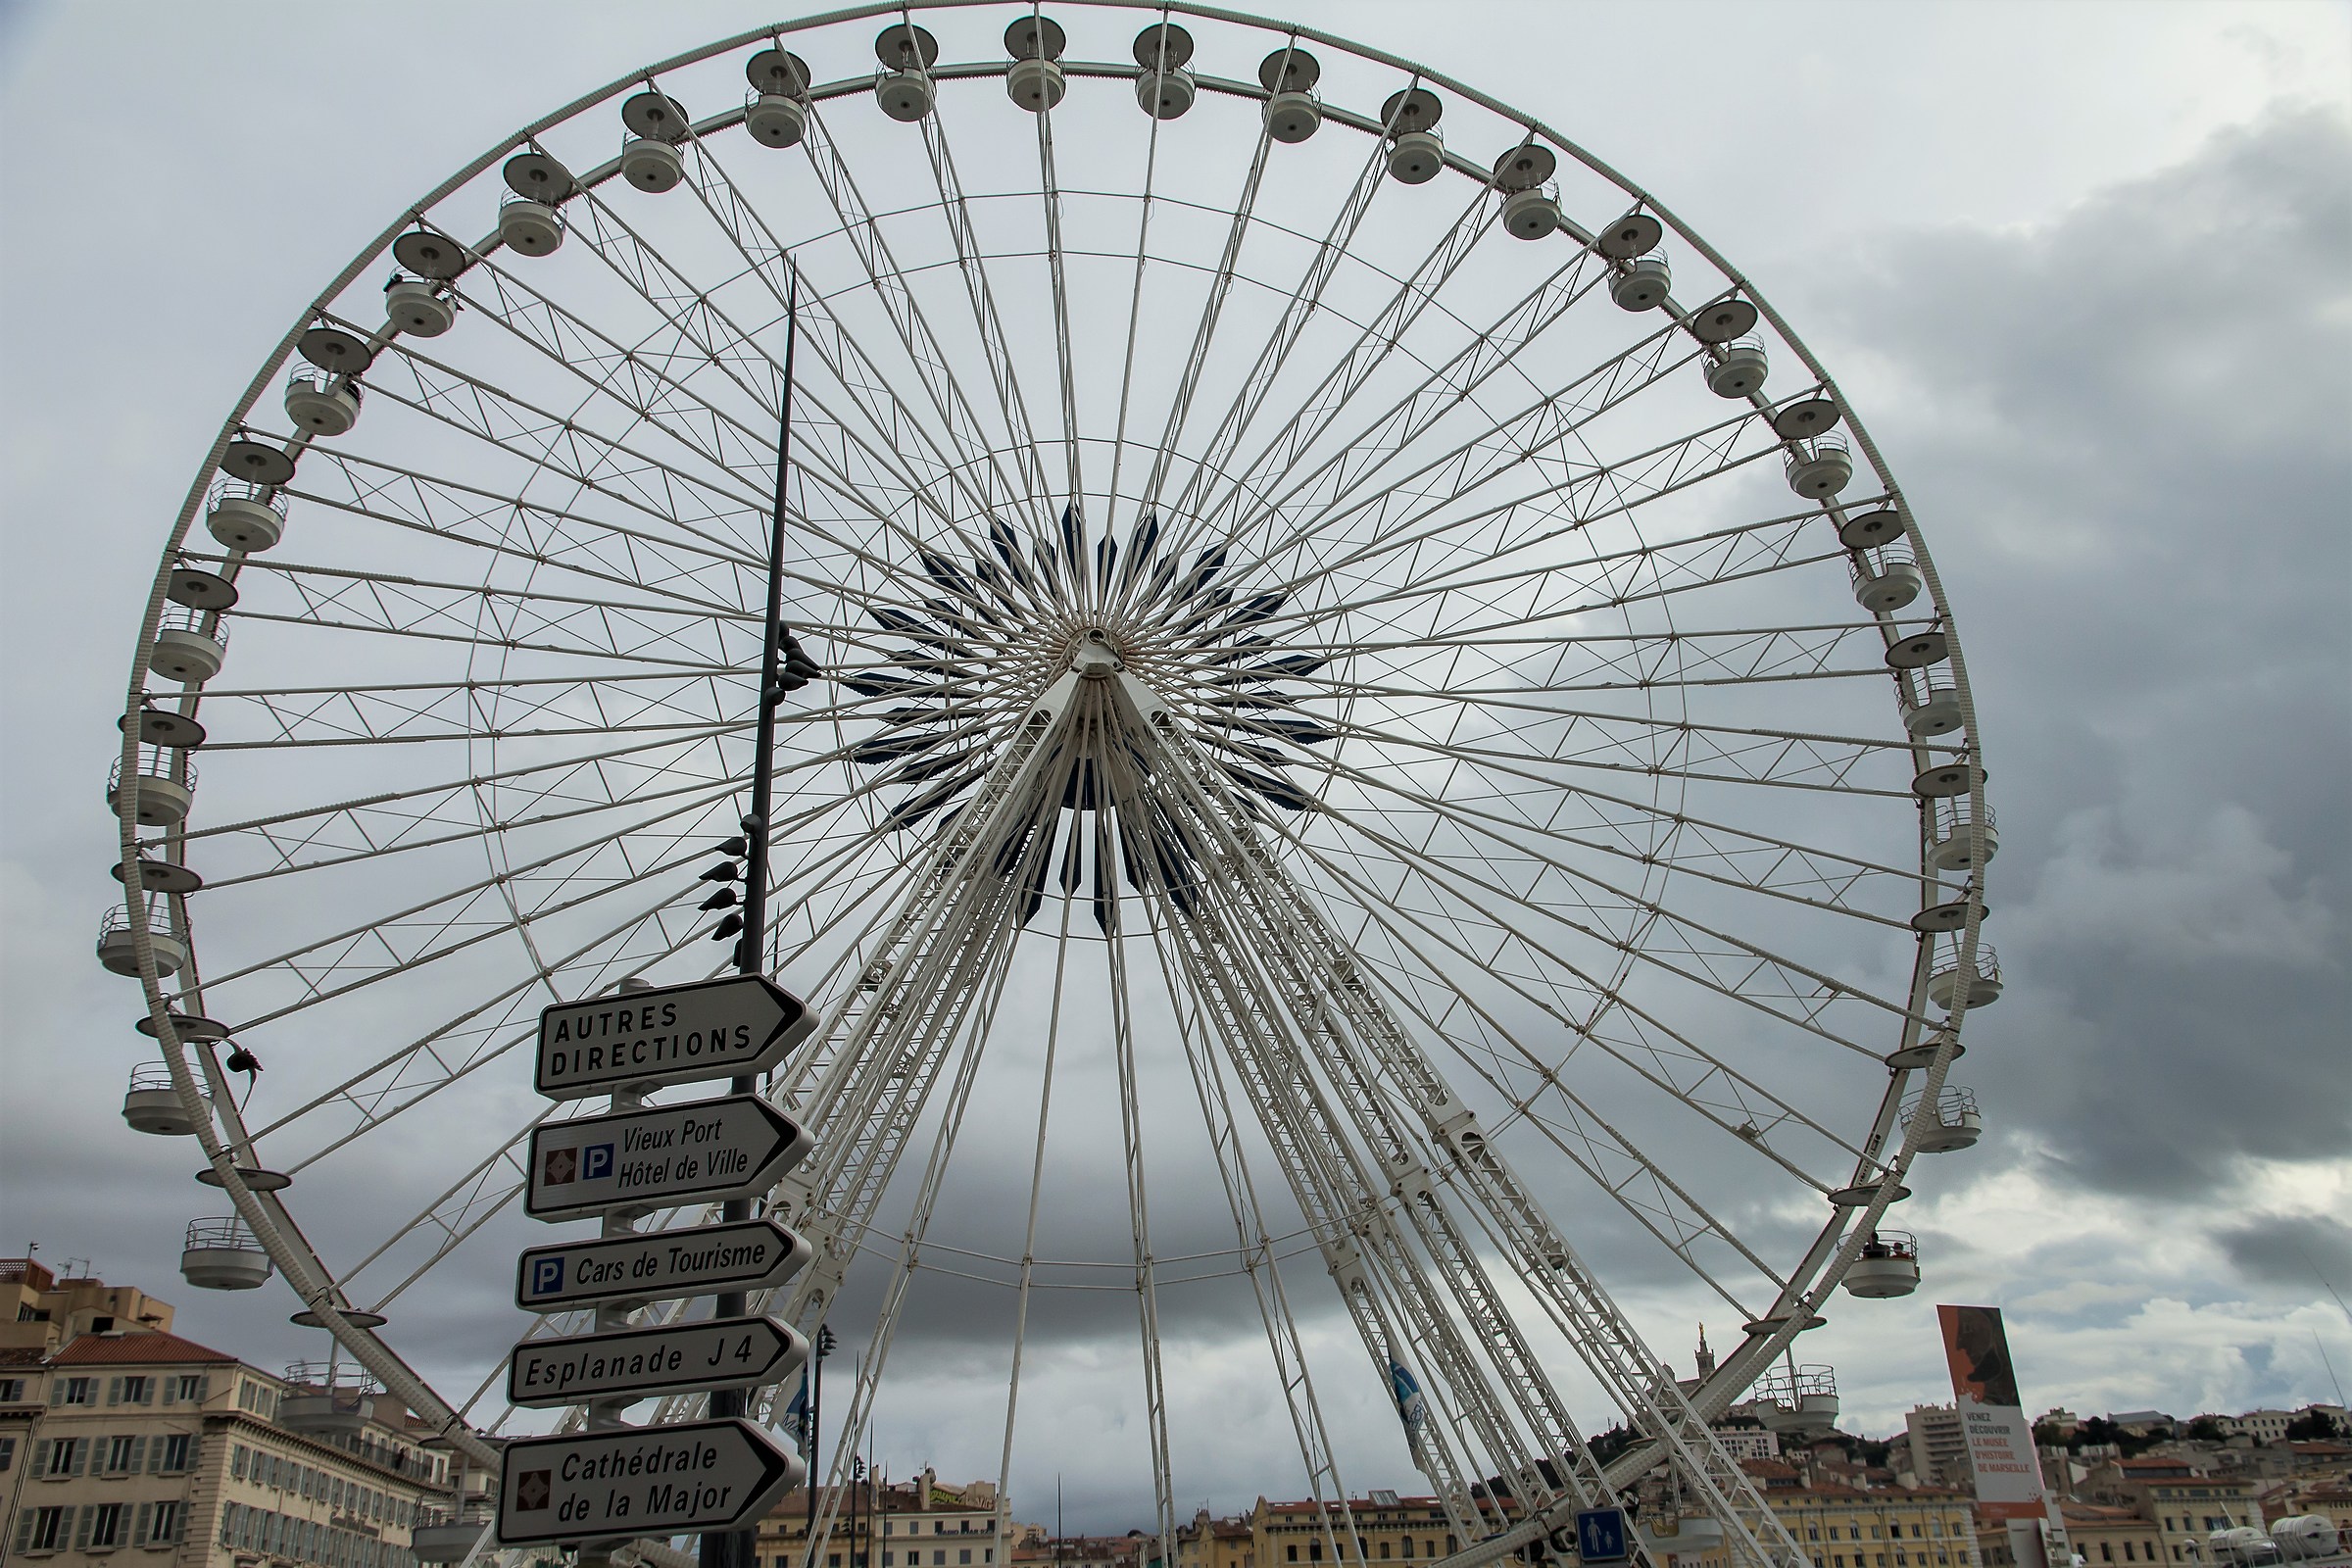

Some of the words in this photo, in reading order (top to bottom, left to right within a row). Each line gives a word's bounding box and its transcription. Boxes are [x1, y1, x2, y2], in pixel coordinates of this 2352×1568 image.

[555, 1003, 677, 1044] AUTRES
[551, 1025, 751, 1076] DIRECTIONS
[624, 1128, 675, 1153] Vieux
[680, 1118, 722, 1146] Port
[617, 1154, 670, 1189] Hôtel
[675, 1153, 699, 1179] de
[707, 1148, 748, 1176] Ville
[576, 1257, 623, 1285] Cars
[632, 1251, 658, 1277] de
[668, 1242, 765, 1274] Tourisme
[525, 1345, 682, 1390] Esplanade
[708, 1338, 724, 1366] J
[734, 1335, 753, 1362] 4
[1966, 1412, 1991, 1422] VENEZ
[1969, 1424, 2011, 1435] DÉCOUVRIR
[561, 1442, 716, 1482] Cathédrale
[1972, 1438, 1982, 1446] LE
[1978, 1463, 1988, 1472] DE
[1989, 1463, 2031, 1473] MARSEILLE
[558, 1493, 590, 1522] de
[605, 1489, 630, 1518] la
[646, 1481, 731, 1519] Major
